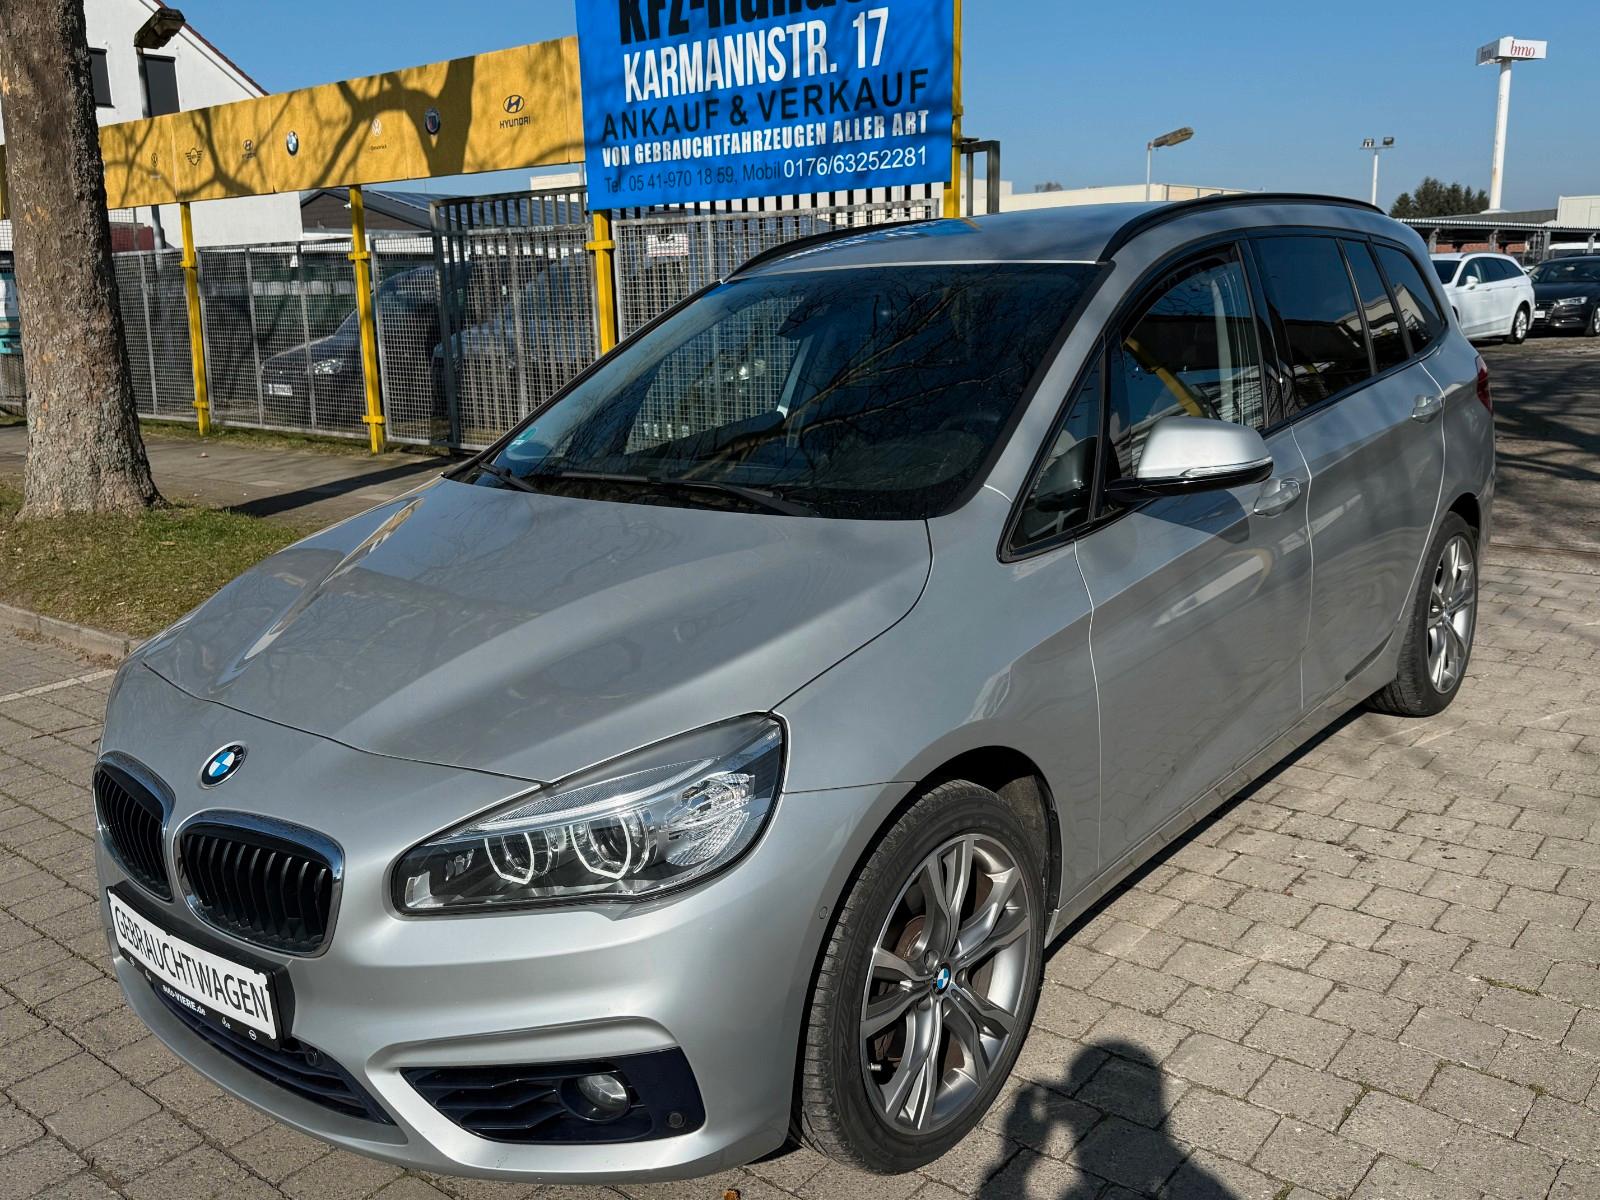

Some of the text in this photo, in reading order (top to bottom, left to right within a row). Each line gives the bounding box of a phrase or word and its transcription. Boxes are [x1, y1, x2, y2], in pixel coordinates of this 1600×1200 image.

[623, 8, 889, 102] KARMANNSTR. 17
[1510, 40, 1536, 57] bmo
[498, 116, 531, 129] HYUNDAI
[602, 68, 929, 142] ANKAUF & VERKAUF
[602, 110, 929, 168] VON GEBRAUCHTFAHRZEUGEN ALLER ART
[742, 161, 781, 181] Mobil
[783, 146, 926, 178] 0176/63252281
[115, 905, 269, 1023] GEBRAUCHTWAGEN
